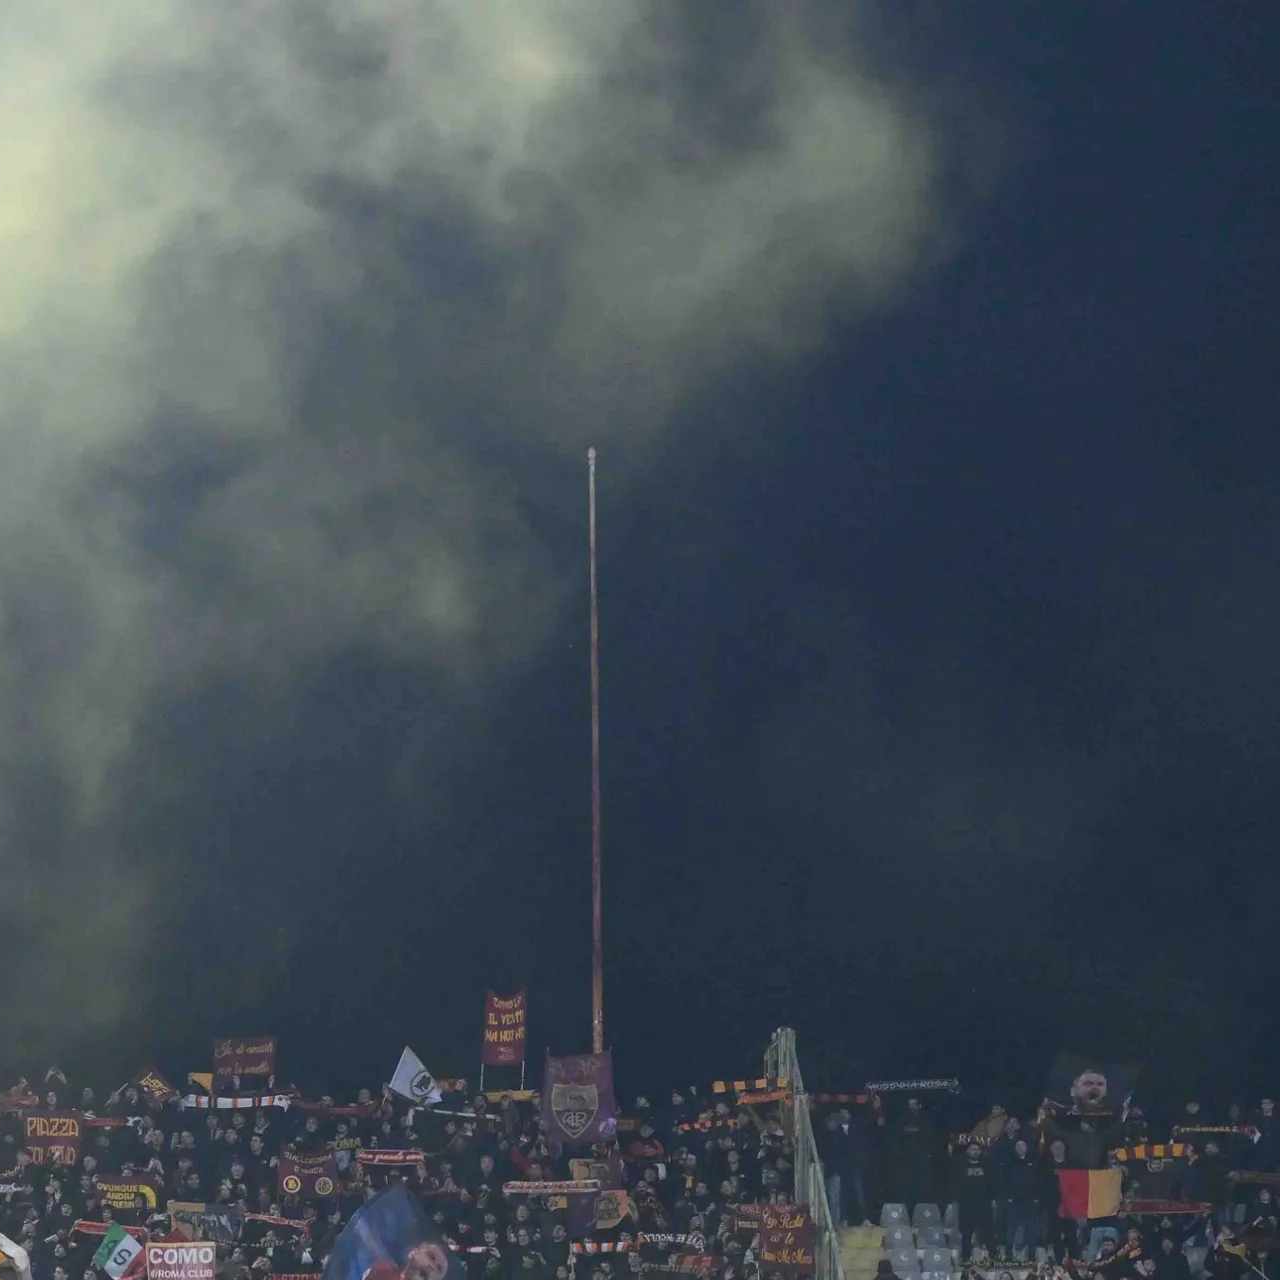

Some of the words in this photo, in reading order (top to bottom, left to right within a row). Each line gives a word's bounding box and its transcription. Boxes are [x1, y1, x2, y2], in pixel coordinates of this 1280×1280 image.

[27, 1116, 79, 1137] PIAZZA
[149, 1248, 213, 1266] COMO
[158, 1269, 185, 1280] ROMA
[188, 1268, 213, 1279] CLUB
